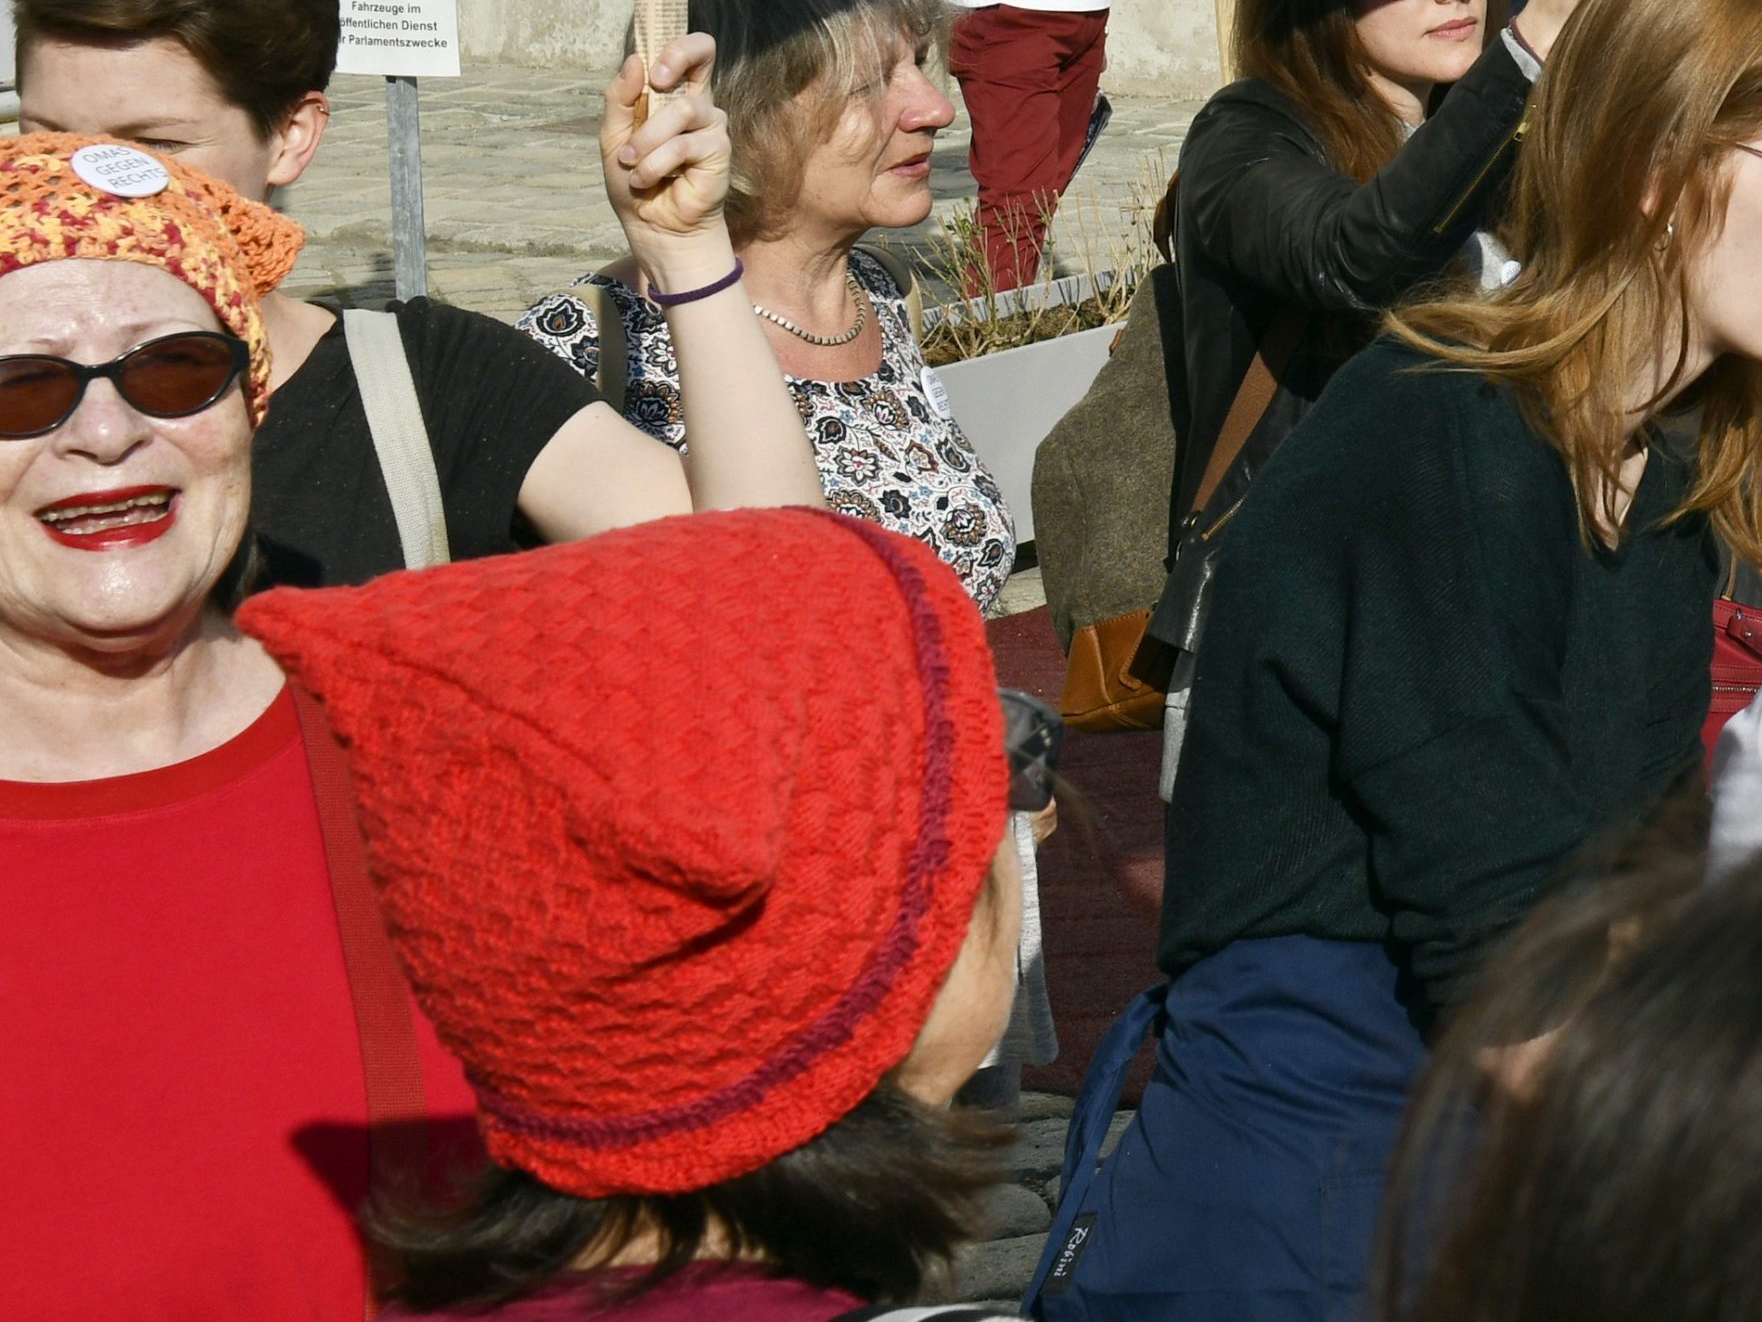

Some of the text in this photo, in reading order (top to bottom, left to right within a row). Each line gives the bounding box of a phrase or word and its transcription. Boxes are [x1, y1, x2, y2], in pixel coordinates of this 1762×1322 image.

[351, 0, 421, 16] Fahrzeuge im
[340, 16, 438, 32] öffentlichen Dienst
[348, 34, 448, 48] Parlamentszwecke
[82, 147, 131, 164] OMAS
[95, 157, 150, 176] GEGEN
[107, 167, 168, 189] RECHTS
